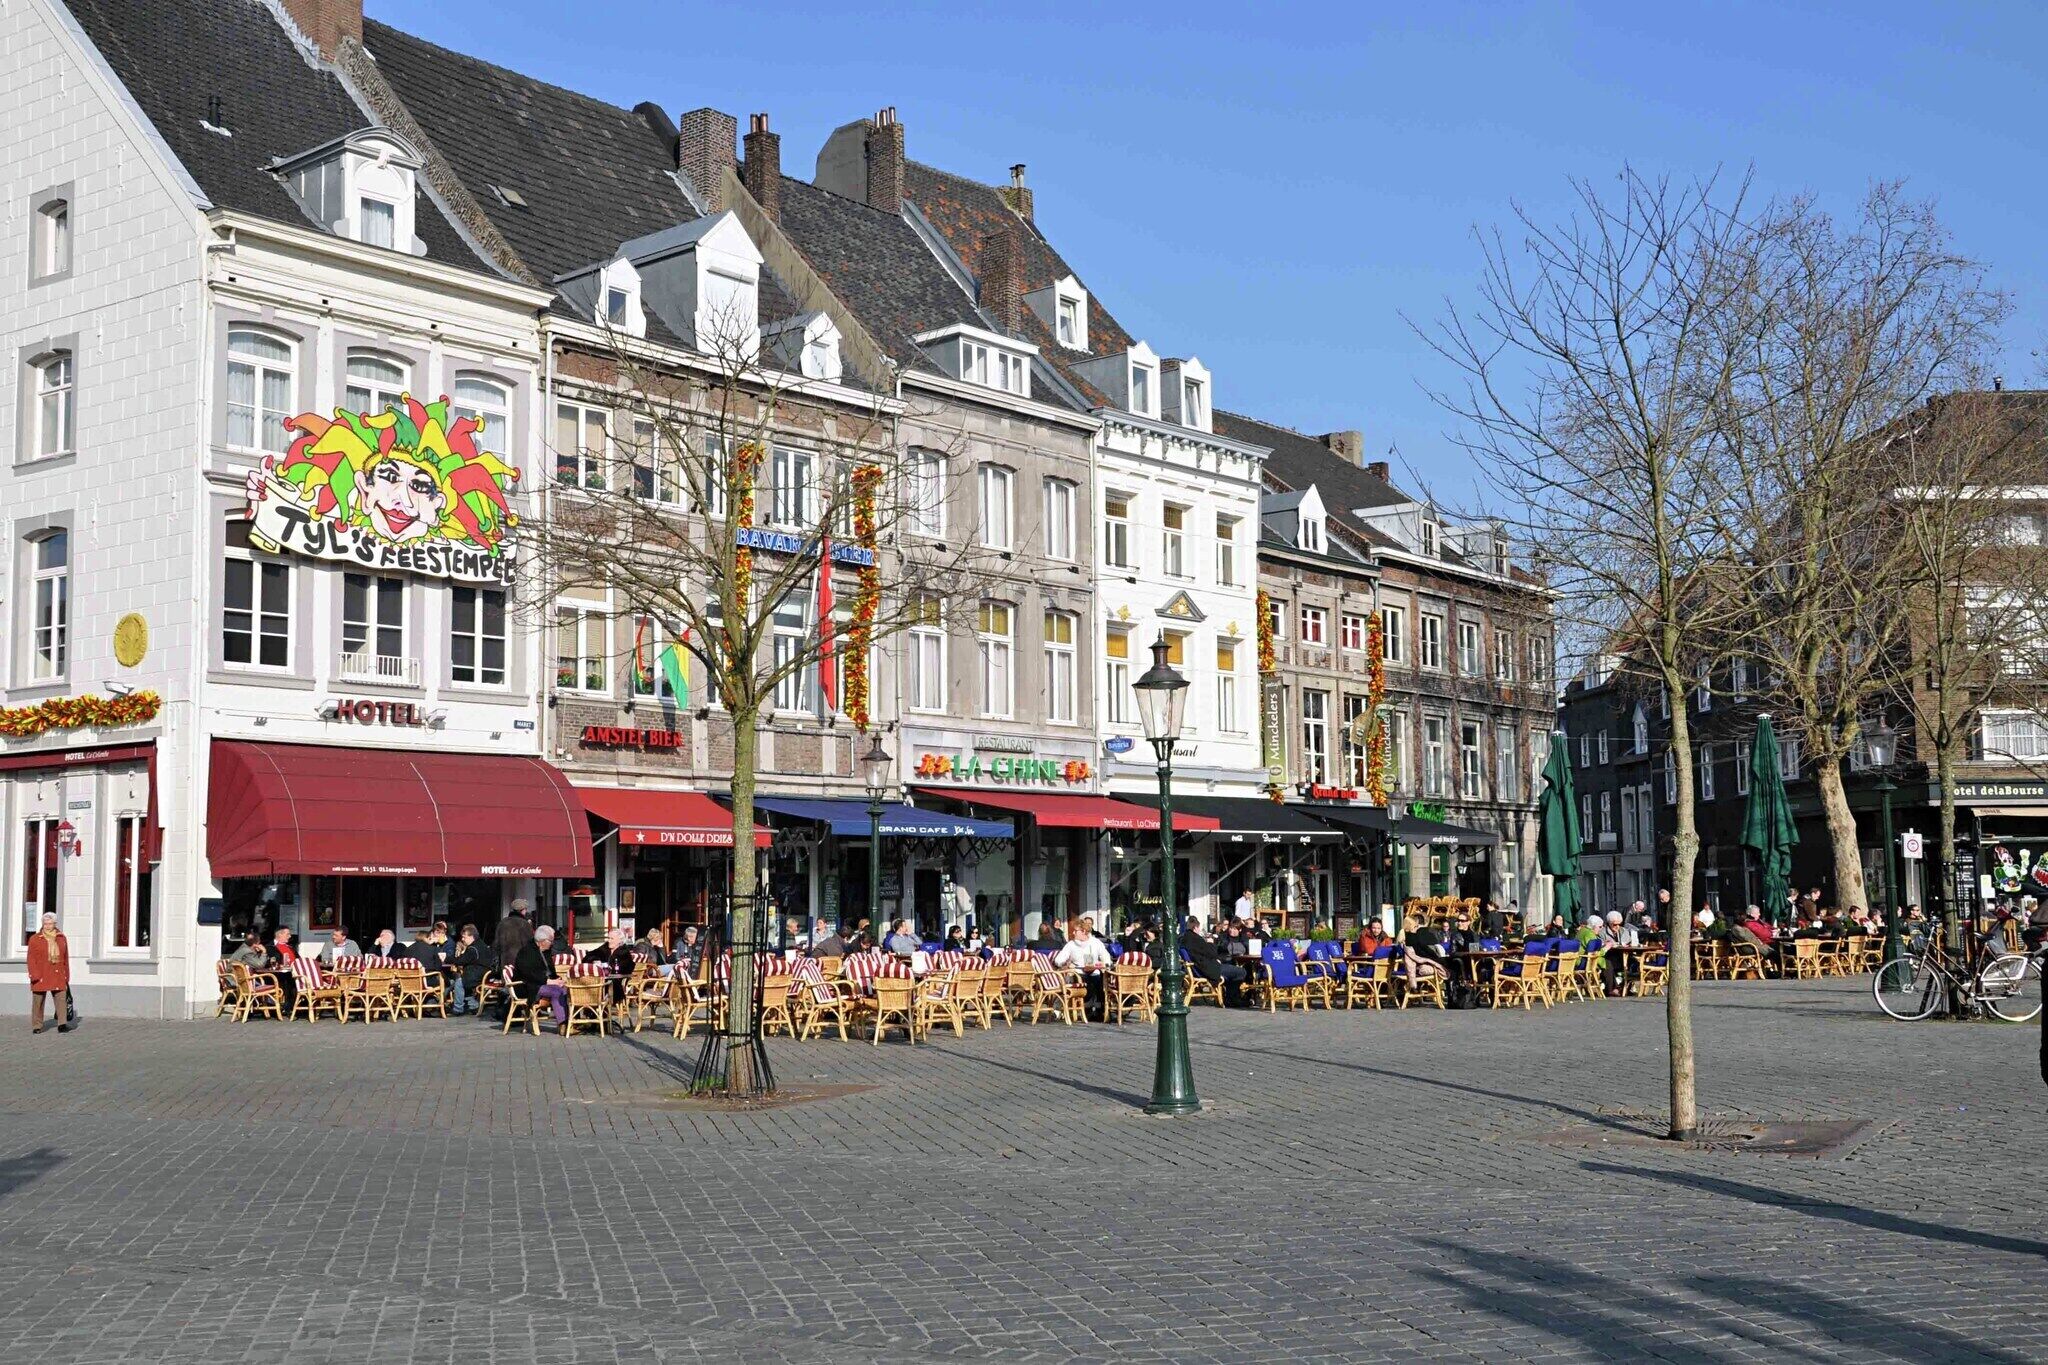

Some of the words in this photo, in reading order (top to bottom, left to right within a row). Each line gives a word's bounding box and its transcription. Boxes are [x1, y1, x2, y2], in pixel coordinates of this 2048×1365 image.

[337, 699, 423, 726] HOTEL
[1266, 693, 1280, 760] Minckelers
[649, 729, 685, 747] BIER
[978, 736, 1033, 751] RESTAURANT
[65, 752, 85, 761] HOTEL
[1173, 744, 1198, 757] usart
[951, 754, 983, 778] LA
[1953, 786, 1977, 796] otel
[1103, 817, 1133, 828] Restaurant
[878, 825, 917, 833] GRAND
[919, 826, 948, 834] CAFE
[481, 865, 510, 875] HOTEL
